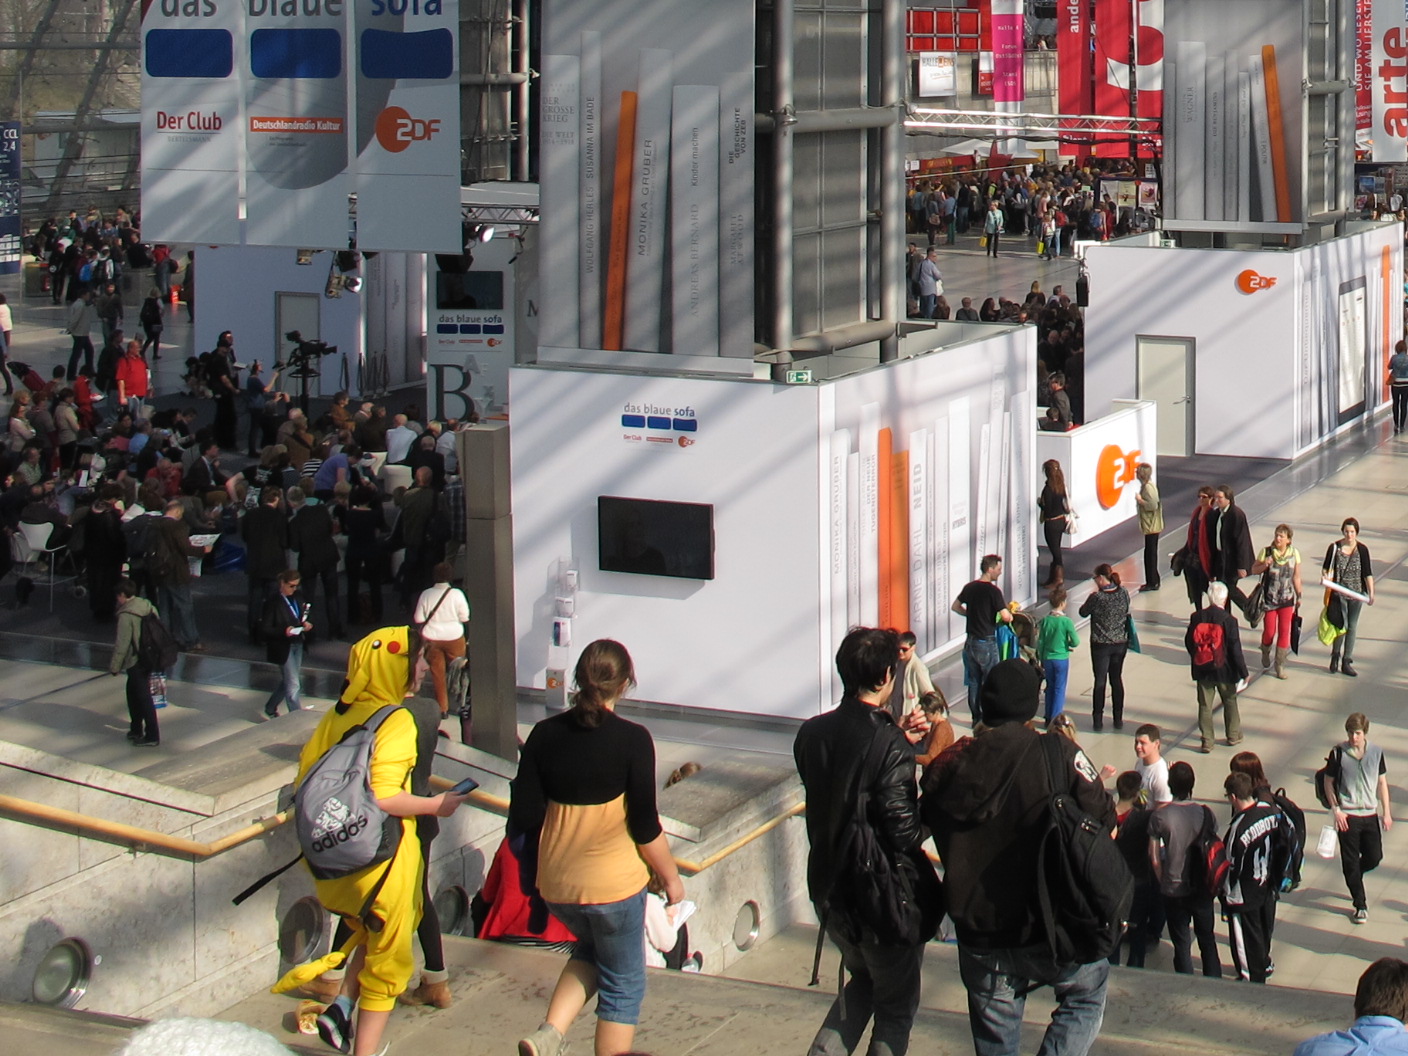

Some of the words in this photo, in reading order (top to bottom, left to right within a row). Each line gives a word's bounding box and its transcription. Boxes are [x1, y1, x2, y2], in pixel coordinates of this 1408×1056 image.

[542, 96, 559, 105] DER
[1379, 27, 1408, 138] arte
[157, 111, 183, 130] Der
[187, 111, 222, 131] Club
[542, 106, 575, 114] GROSSE
[542, 115, 568, 123] KRIEG
[586, 97, 595, 120] BADE
[1186, 87, 1194, 123] WAGNER
[253, 119, 316, 131] Deutschlandradio
[317, 120, 340, 131] Kultur
[555, 131, 575, 139] WELT
[586, 123, 595, 134] IM
[586, 135, 595, 179] SUSANNA
[641, 139, 652, 196] GRUBER
[586, 186, 595, 220] HERLES
[638, 201, 648, 256] MONIKA
[690, 203, 698, 259] BERNARD
[586, 224, 595, 274] WOLFGANG
[690, 261, 698, 316] ANDREAS
[439, 314, 454, 323] das
[456, 314, 481, 323] blaue
[483, 315, 502, 323] sofa
[430, 364, 476, 423] B
[624, 402, 641, 413] das
[643, 403, 672, 415] blaue
[674, 406, 695, 417] sofa
[913, 464, 922, 510] NEID
[912, 521, 922, 572] DAHL
[912, 576, 922, 623] ARNE
[312, 815, 368, 853] adidas
